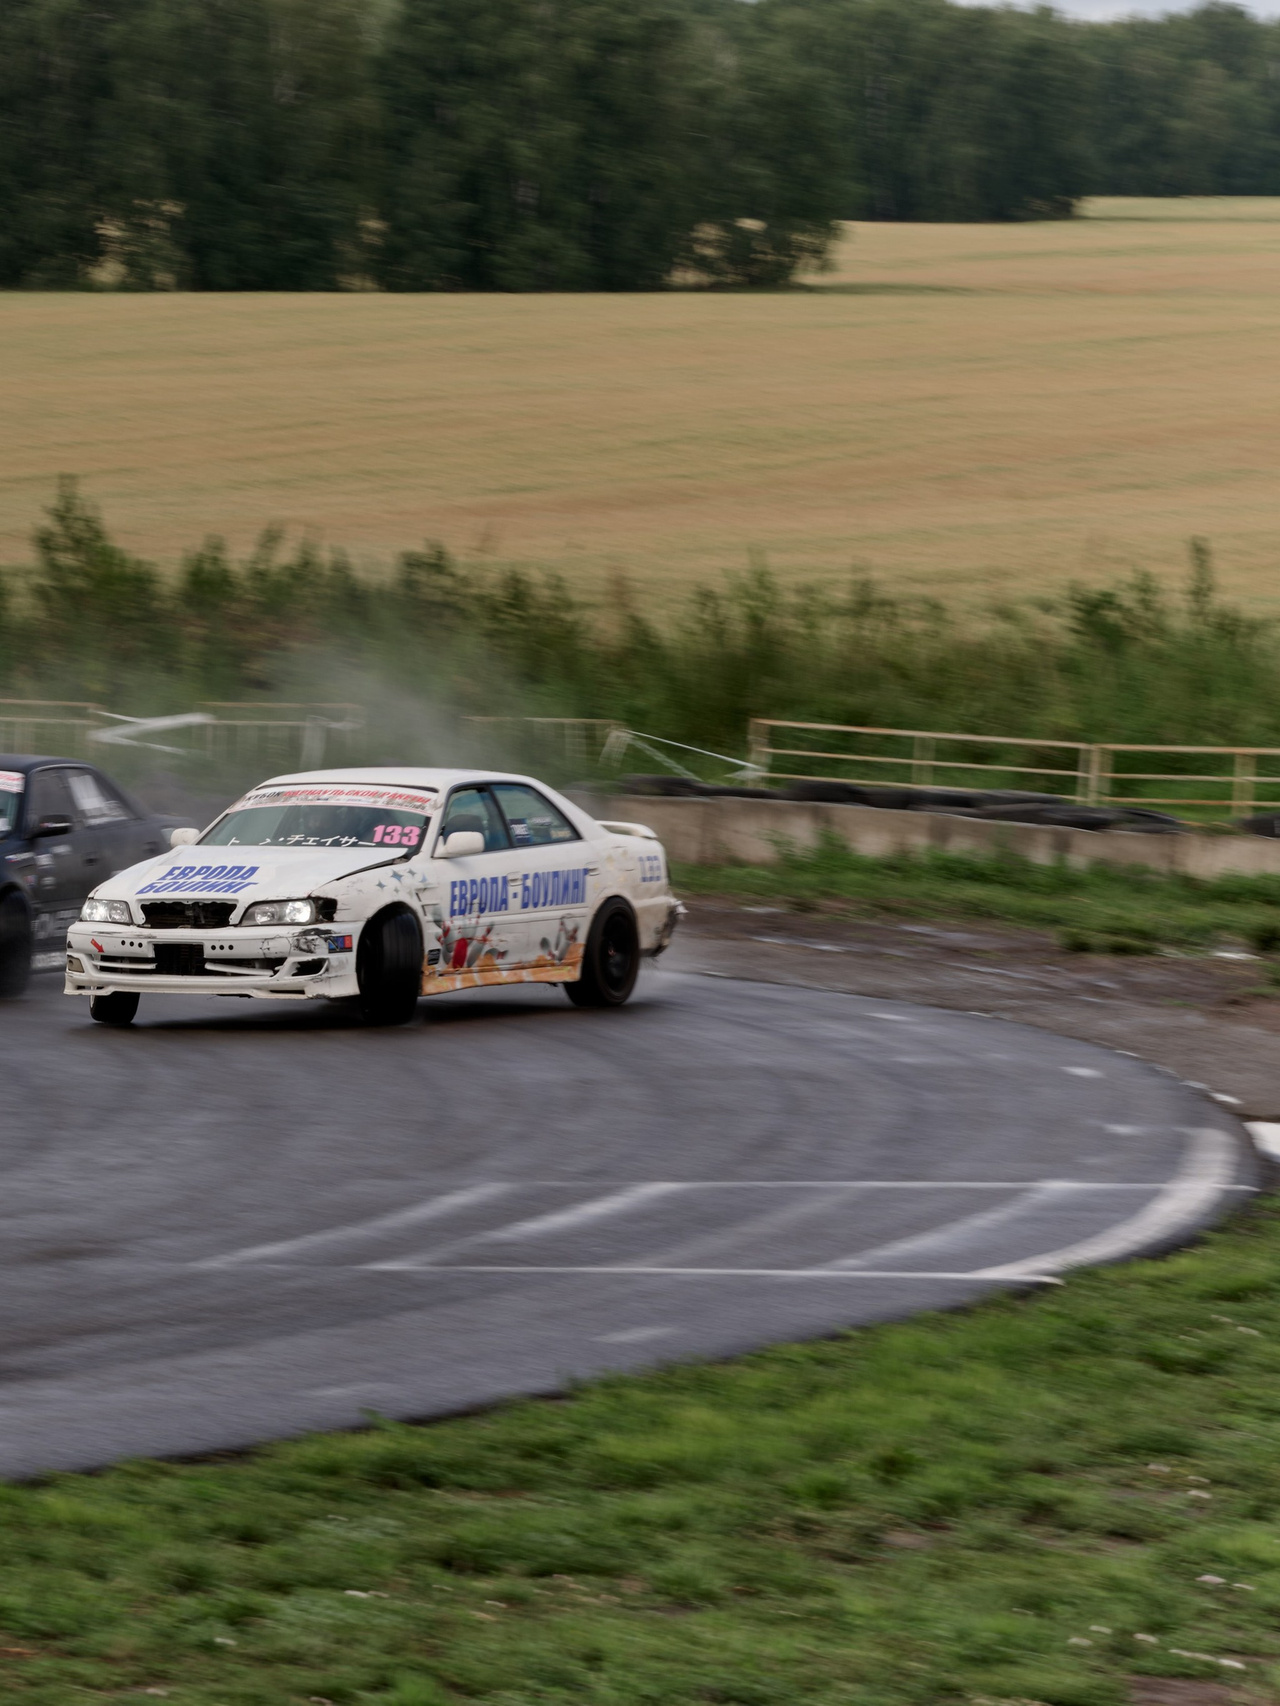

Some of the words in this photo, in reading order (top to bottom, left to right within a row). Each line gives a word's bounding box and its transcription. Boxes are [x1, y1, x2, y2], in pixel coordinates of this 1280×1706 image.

[372, 824, 421, 846] 133
[156, 865, 260, 880] ЕВРОПА
[135, 880, 259, 895] БОУЛИНГ
[450, 875, 509, 917] ЕВРОПА
[521, 867, 589, 909] БОУЛИНГ
